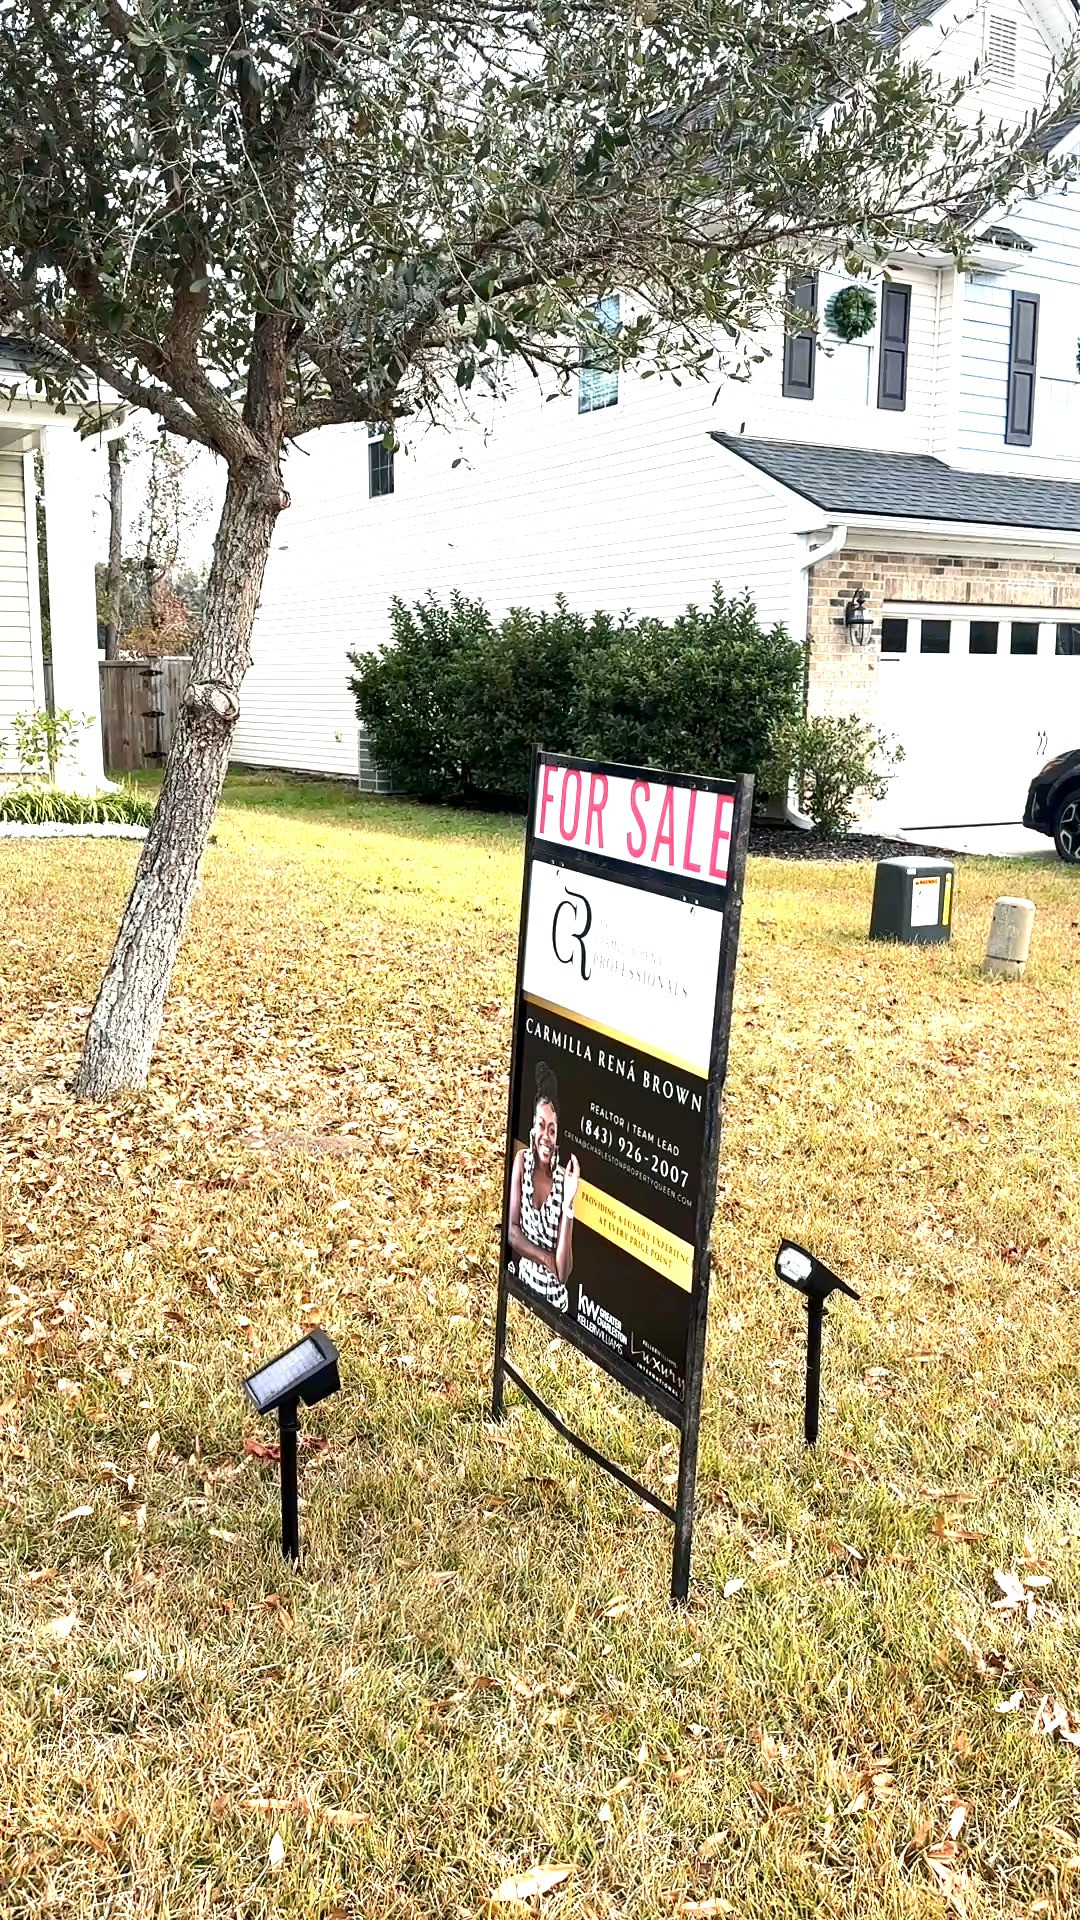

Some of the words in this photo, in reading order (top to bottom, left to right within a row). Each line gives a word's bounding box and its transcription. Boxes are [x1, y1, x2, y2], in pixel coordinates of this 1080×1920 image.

[539, 764, 609, 849] FOR
[626, 778, 735, 880] SALE
[526, 1018, 592, 1062] CARMILLA
[598, 1050, 636, 1082] RENÁ
[643, 1070, 702, 1113] BROWN
[580, 1115, 613, 1148] (843)
[618, 1137, 689, 1188] 926-2007
[590, 1102, 625, 1127] REALTOR
[632, 1124, 655, 1143] TEAM
[657, 1138, 680, 1156] LEAD
[581, 1191, 617, 1219] PROVIDING
[623, 1217, 650, 1241] LUXURY
[652, 1235, 691, 1266] EXPERIENC
[599, 1216, 607, 1227] AT
[608, 1222, 628, 1240] EVERY
[629, 1235, 649, 1255] PRICE
[650, 1248, 672, 1269] POINT
[596, 1316, 628, 1346] CHARLESTON
[599, 1307, 622, 1331] GREATER
[630, 1331, 685, 1402] Luxury
